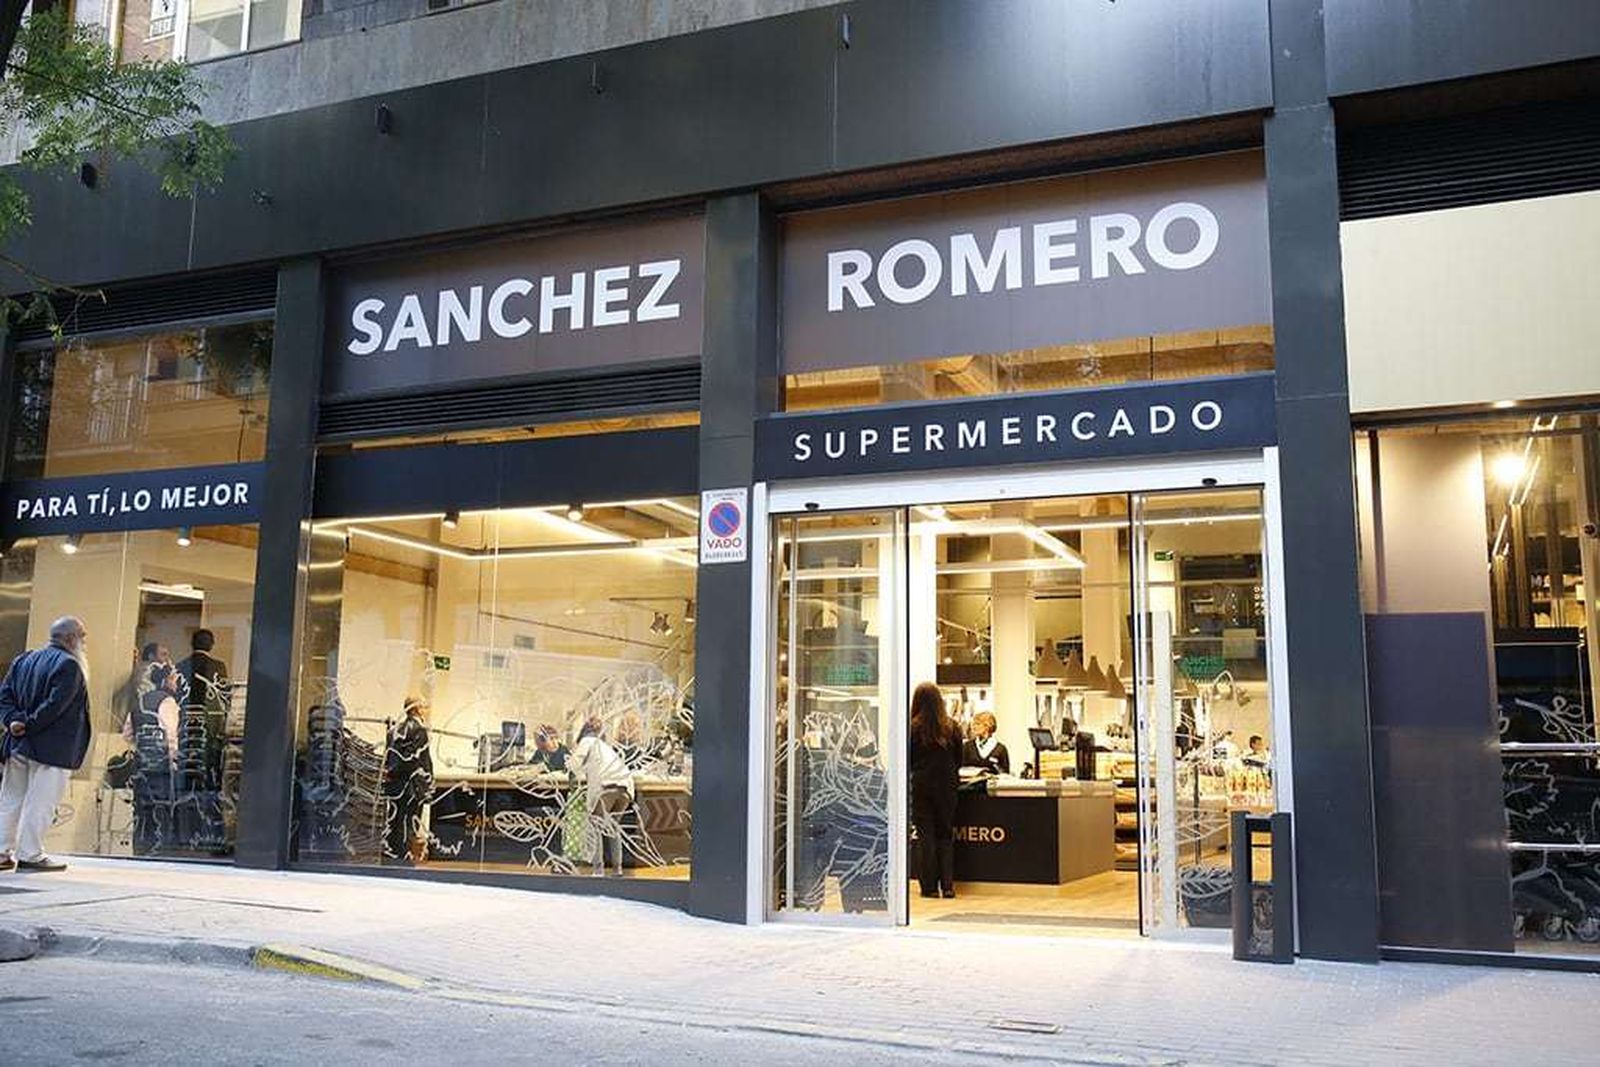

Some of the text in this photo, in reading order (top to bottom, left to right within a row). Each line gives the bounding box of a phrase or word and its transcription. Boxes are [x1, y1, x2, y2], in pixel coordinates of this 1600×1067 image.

[347, 202, 1220, 355] SANCHEZ ROMERO
[794, 400, 1223, 461] SUPERMERCADO
[16, 495, 78, 520] PARA
[161, 482, 249, 509] MEJOR
[706, 537, 742, 549] VADO
[951, 826, 1006, 842] MERO
